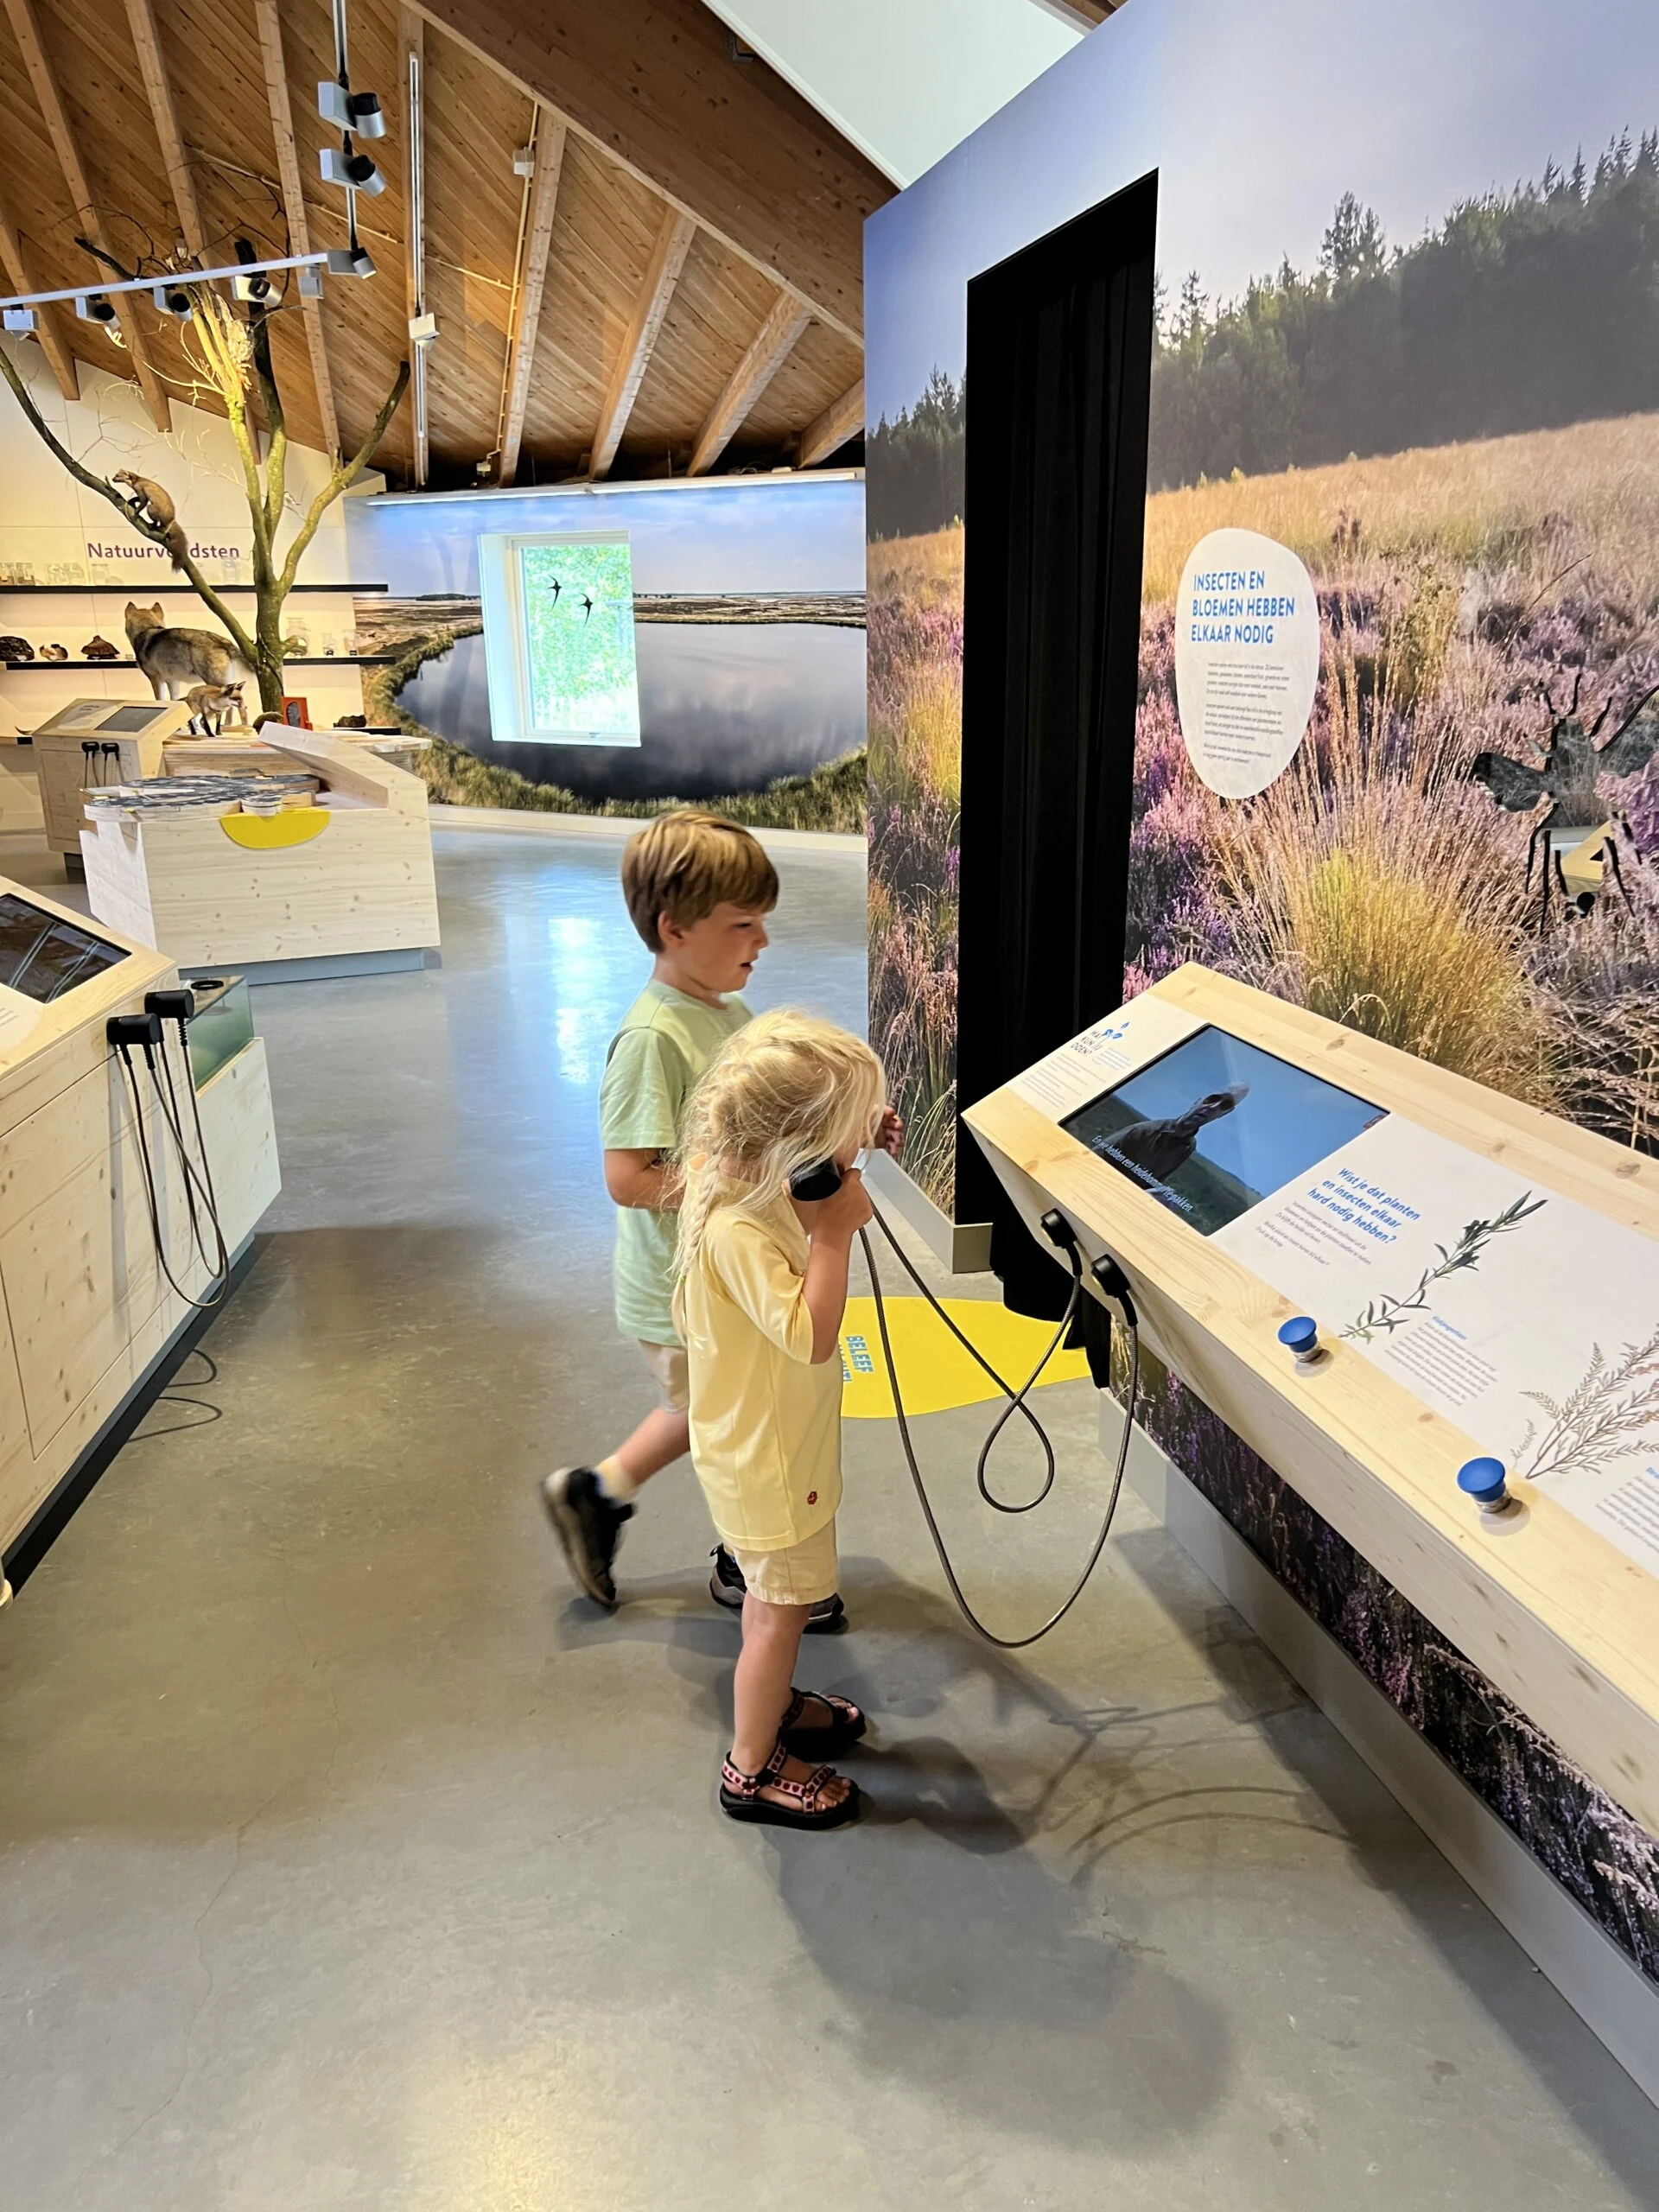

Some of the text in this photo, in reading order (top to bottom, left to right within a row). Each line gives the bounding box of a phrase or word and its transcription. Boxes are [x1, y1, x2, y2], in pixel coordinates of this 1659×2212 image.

[1193, 570, 1265, 591] INSECTEN EN
[1192, 597, 1294, 616] BLOEMEN HEBBEN
[1191, 624, 1274, 644] ELKAAR NODIG
[1105, 1145, 1125, 1162] hebben
[1122, 1158, 1135, 1168] een
[1322, 1179, 1402, 1228] en insecten elkaar
[1338, 1168, 1421, 1220] Wist je dat planten
[1307, 1188, 1397, 1243] hard nodig hebben?
[846, 1336, 874, 1372] BELEEF
